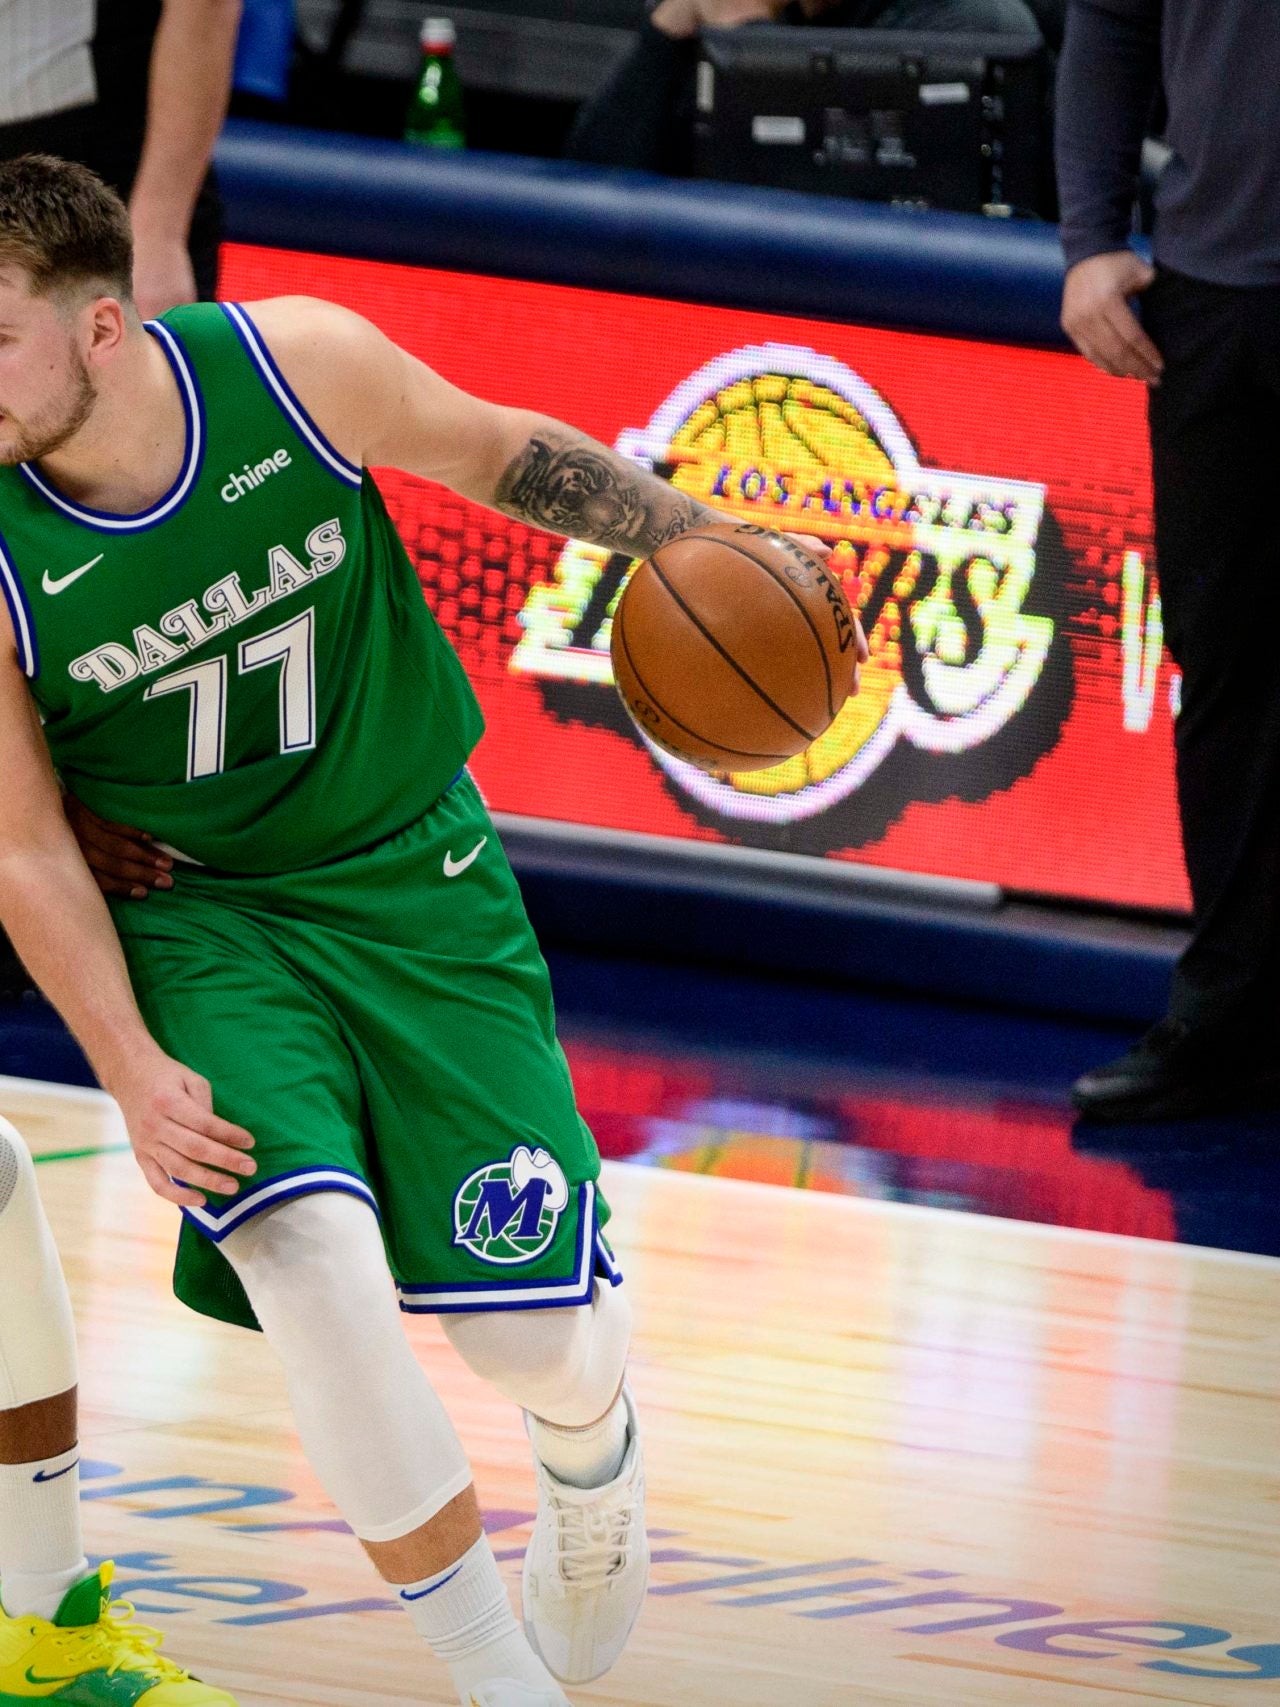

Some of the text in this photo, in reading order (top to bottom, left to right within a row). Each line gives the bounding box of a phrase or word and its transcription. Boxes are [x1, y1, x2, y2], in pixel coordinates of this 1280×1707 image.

[220, 447, 293, 503] chime
[68, 517, 347, 694] DALLAS
[143, 605, 317, 783] 77
[456, 1176, 554, 1241] M
